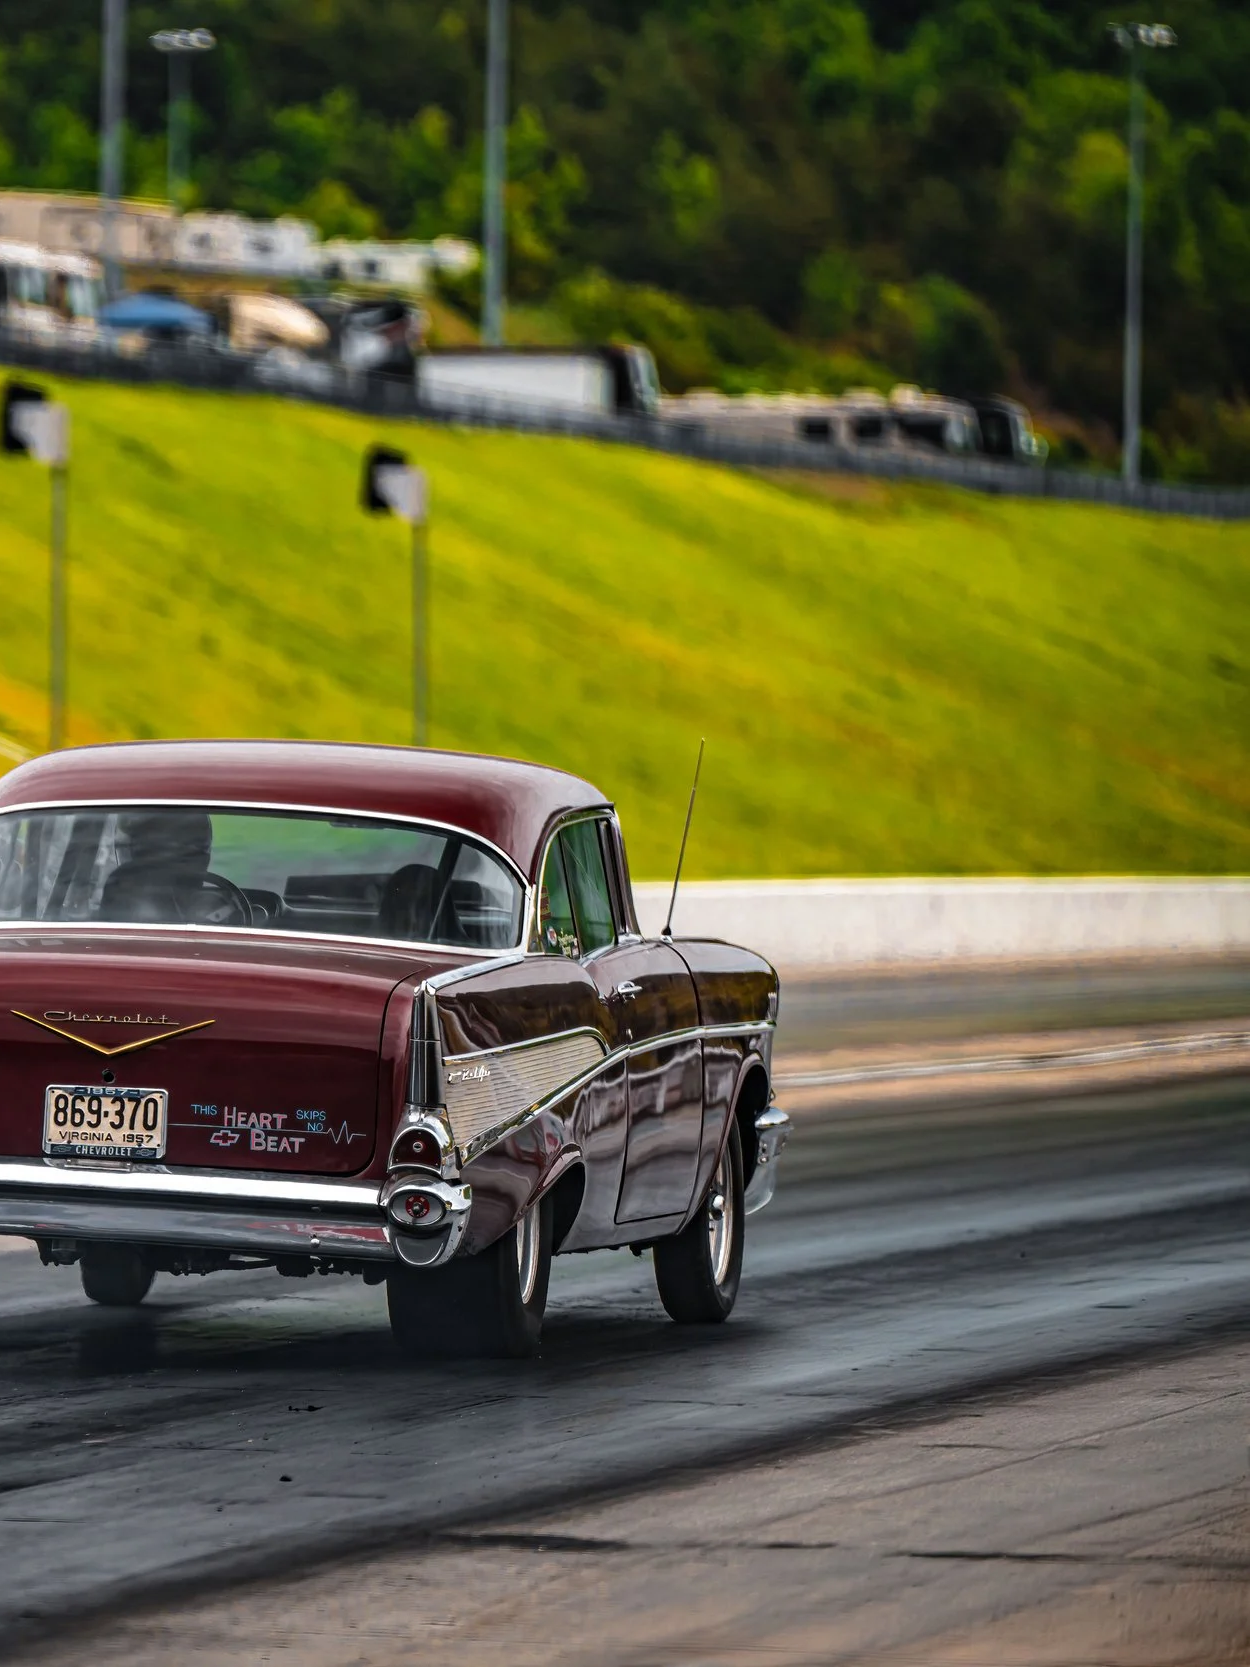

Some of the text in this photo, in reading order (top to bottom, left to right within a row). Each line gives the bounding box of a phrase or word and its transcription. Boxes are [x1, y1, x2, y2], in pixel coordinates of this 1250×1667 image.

[44, 1011, 179, 1025] Chevrolet
[191, 1104, 327, 1130] THIS HEART SKIPS
[307, 1122, 324, 1132] NO
[59, 1131, 154, 1144] VIRGINIA 1957
[250, 1128, 306, 1154] BEAT
[75, 1145, 132, 1156] CHEVROLET
